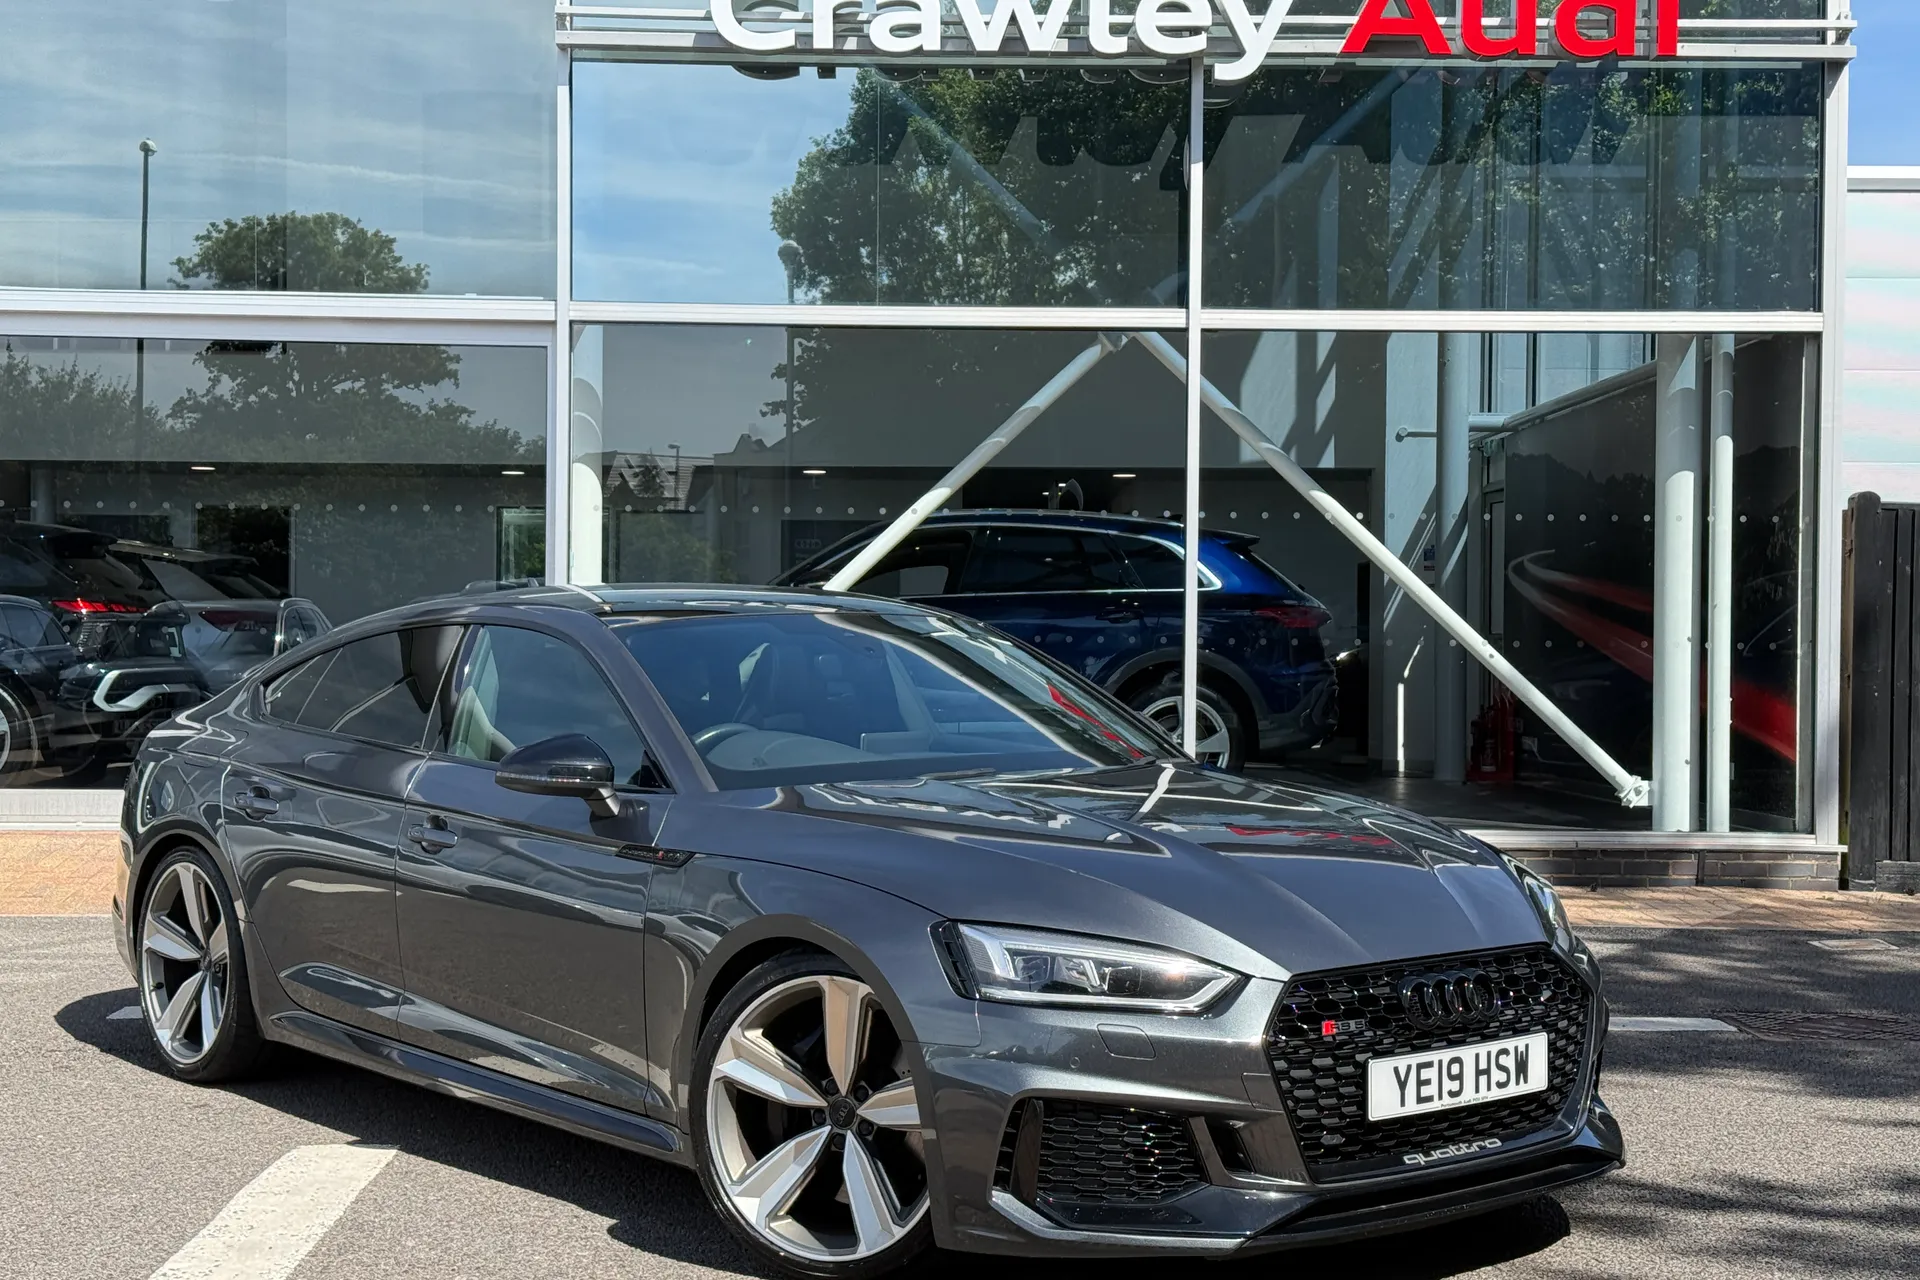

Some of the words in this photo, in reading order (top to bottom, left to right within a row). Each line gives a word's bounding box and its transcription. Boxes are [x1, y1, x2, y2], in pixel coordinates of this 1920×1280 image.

[711, 0, 1290, 82] Crawley
[1339, 0, 1680, 57] Audi
[1393, 1056, 1464, 1108] YE19
[1475, 1043, 1529, 1094] HSW
[1403, 1138, 1502, 1165] quattro
